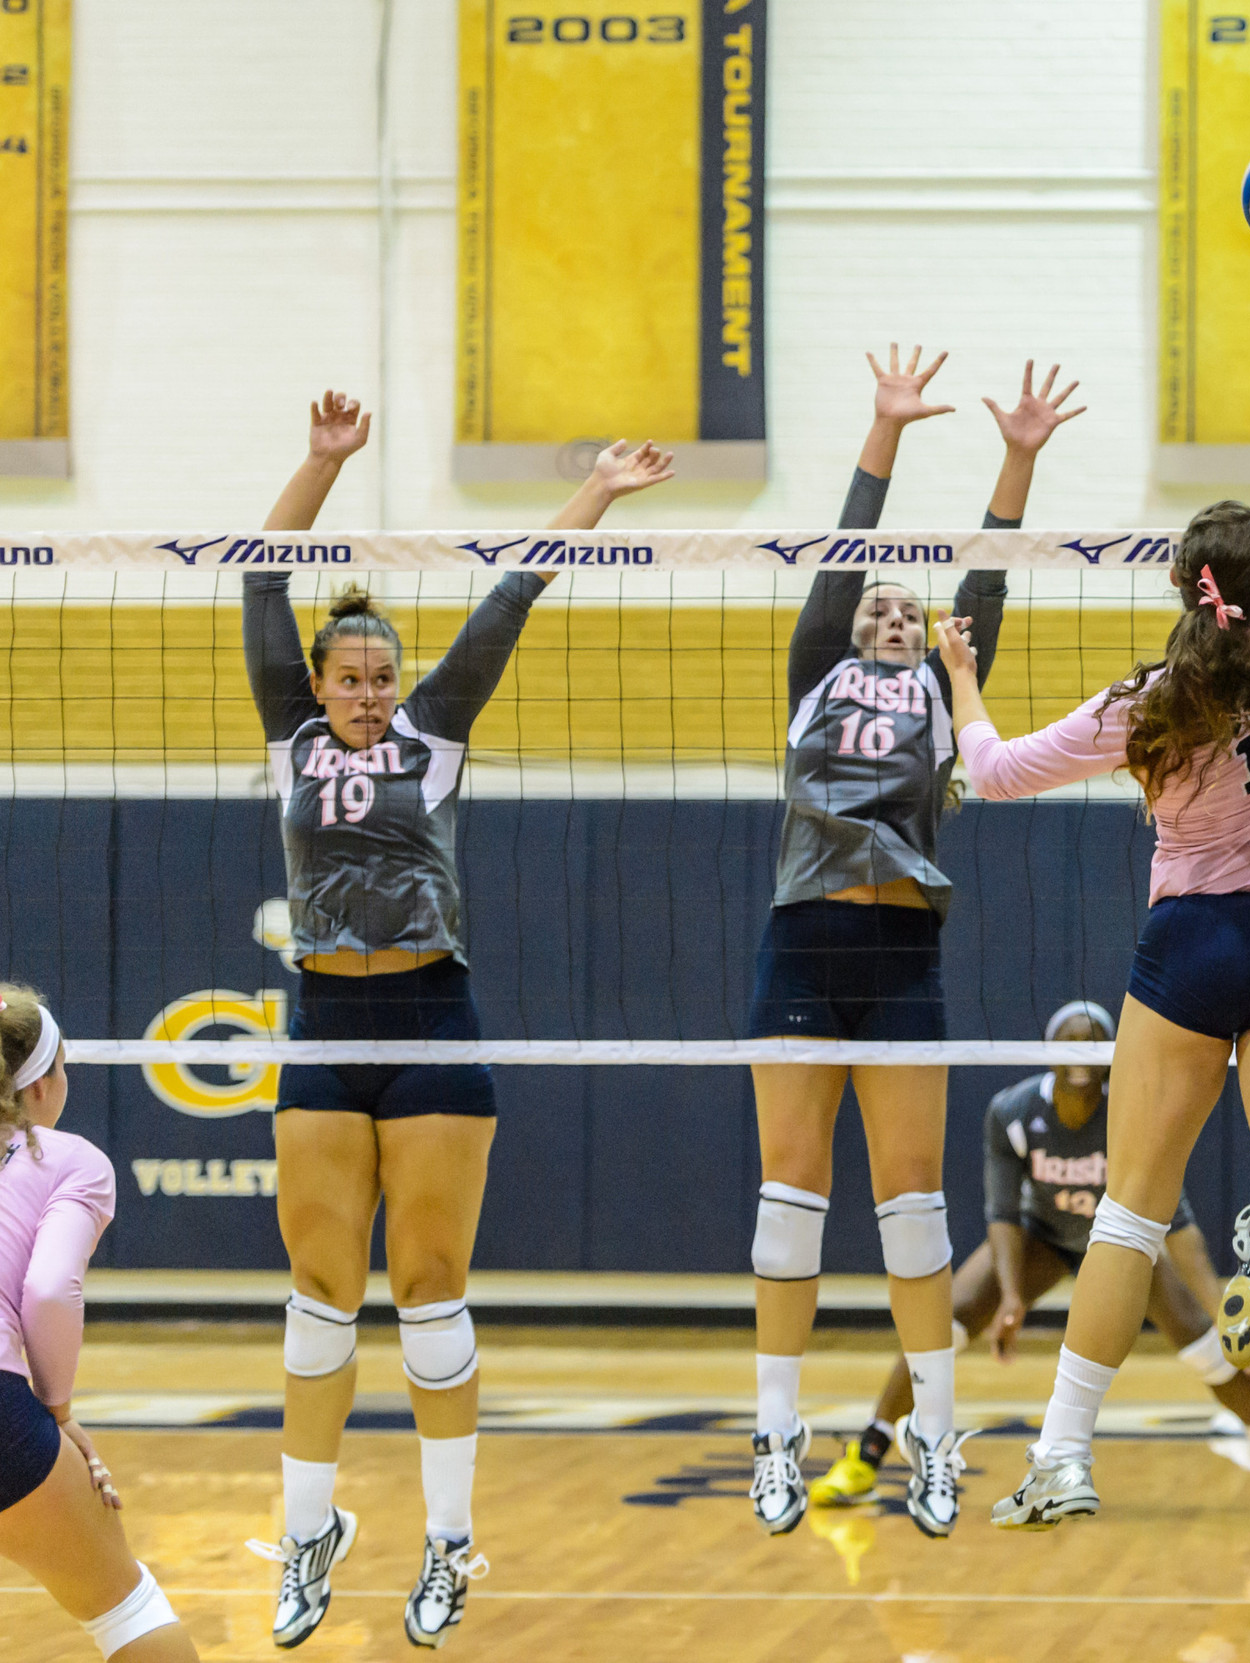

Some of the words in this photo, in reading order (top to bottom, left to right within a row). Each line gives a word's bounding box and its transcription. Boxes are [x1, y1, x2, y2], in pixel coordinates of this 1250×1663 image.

[507, 16, 685, 43] 2003
[722, 23, 753, 378] TOURNAMENT
[837, 708, 896, 759] 16
[318, 774, 375, 827] 19
